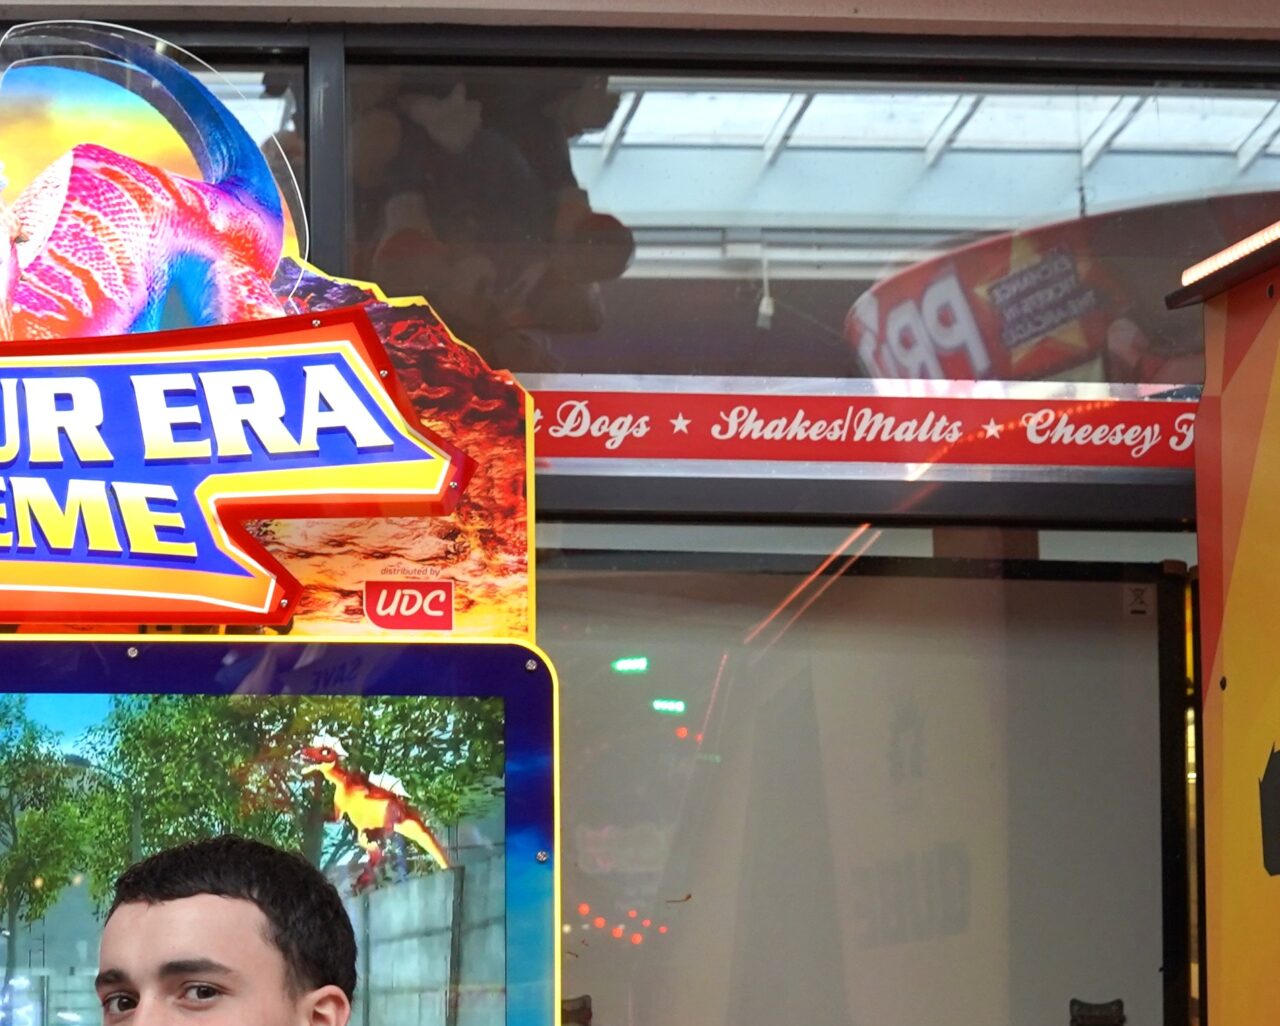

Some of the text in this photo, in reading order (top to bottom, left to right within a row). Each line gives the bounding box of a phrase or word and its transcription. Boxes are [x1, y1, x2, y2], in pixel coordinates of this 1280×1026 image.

[130, 364, 393, 465] ERA
[548, 400, 650, 449] Dogs
[1021, 408, 1161, 458] Cheesey
[380, 567, 441, 577] distributed by
[376, 589, 447, 616] UDC
